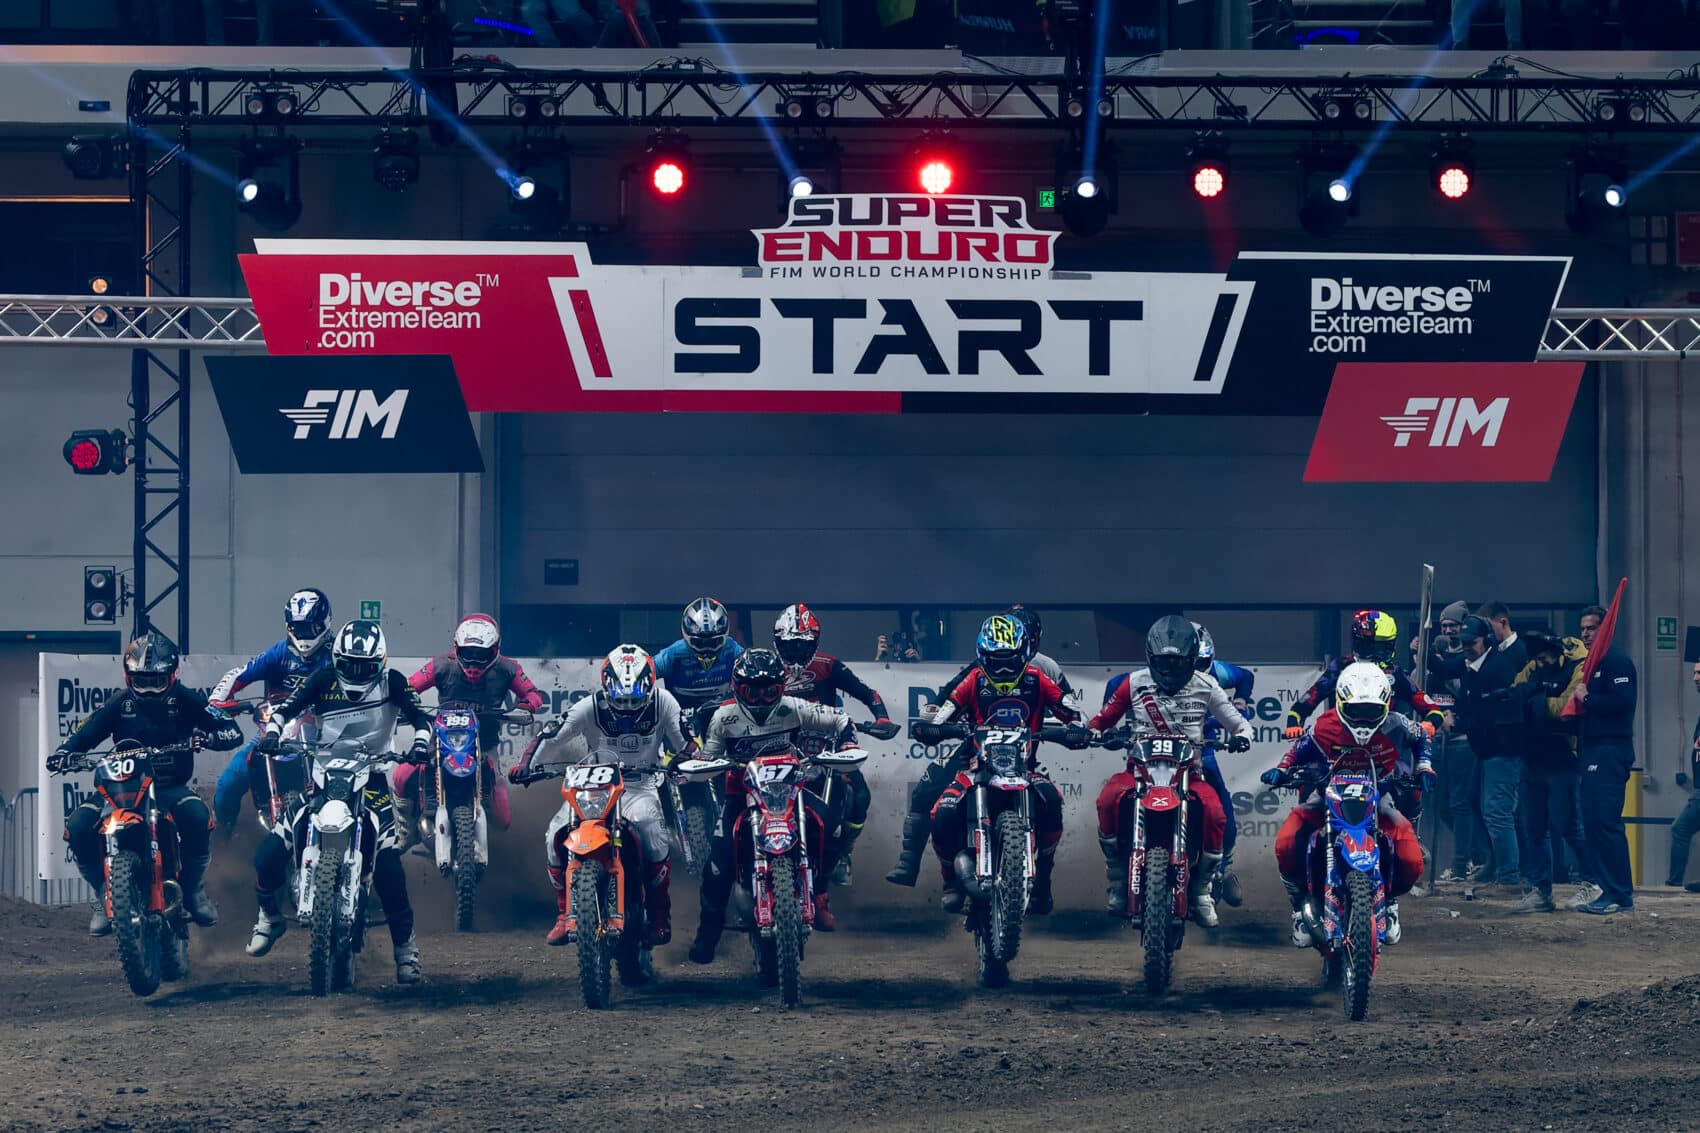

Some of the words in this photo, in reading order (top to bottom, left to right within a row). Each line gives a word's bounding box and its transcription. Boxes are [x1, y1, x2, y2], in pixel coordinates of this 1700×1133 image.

[788, 197, 1024, 228] SUPER
[761, 230, 1052, 264] ENDURO
[770, 267, 802, 278] FIM
[812, 266, 881, 278] WORLD
[891, 266, 1042, 280] CHAMPIONSHIP
[319, 273, 481, 307] Diverse
[1310, 278, 1472, 312] Diverse
[319, 307, 481, 329] ExtremeTeam
[1310, 311, 1472, 335] ExtremeTeam
[317, 330, 375, 349] .com
[674, 298, 1143, 376] START
[1308, 335, 1366, 353] .com
[280, 389, 409, 440] FIM
[1379, 397, 1510, 447] FIM
[984, 730, 1021, 745] 27
[1152, 739, 1173, 753] 39
[111, 758, 135, 776] 30
[569, 766, 614, 787] 48
[758, 765, 794, 781] 67
